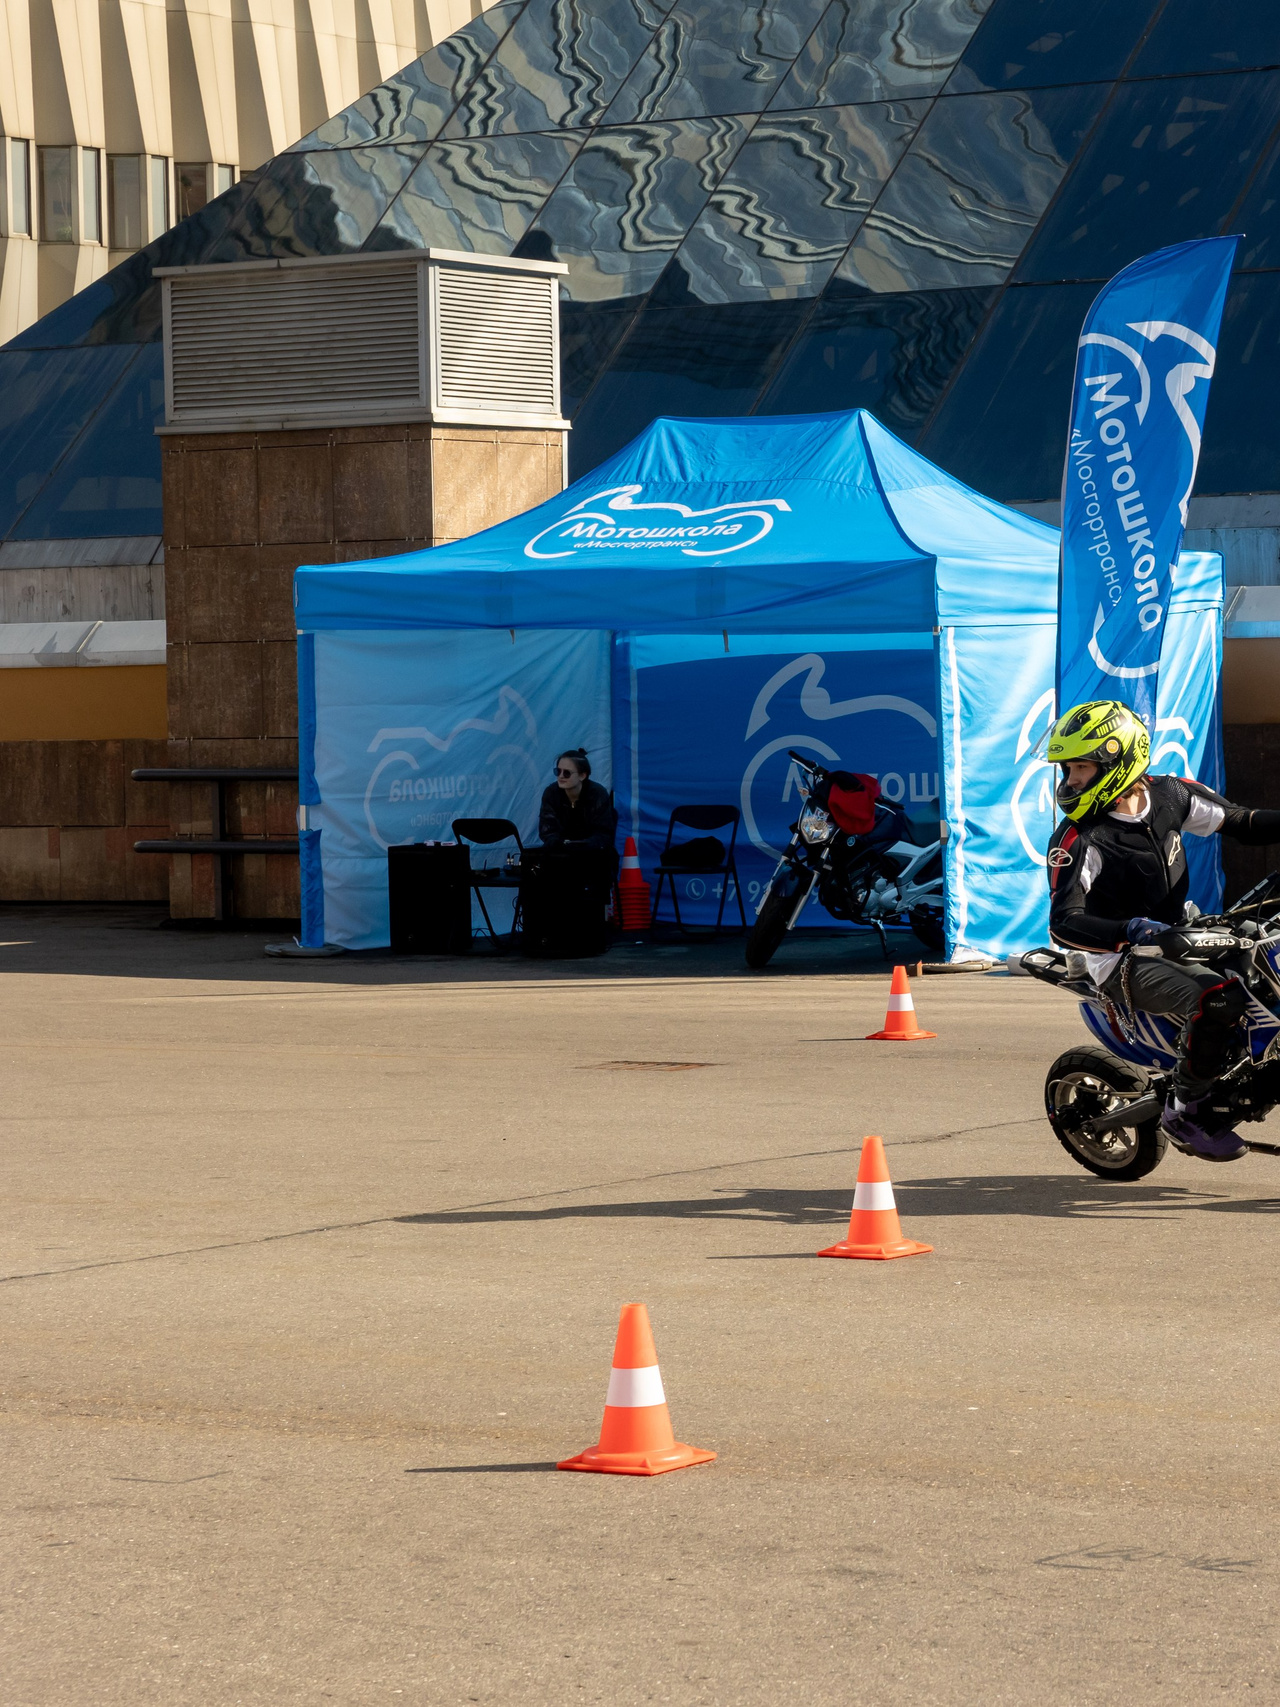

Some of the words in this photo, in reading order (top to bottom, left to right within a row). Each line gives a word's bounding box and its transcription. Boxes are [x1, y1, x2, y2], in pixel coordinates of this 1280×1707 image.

[1084, 372, 1163, 632] Мотошкола
[559, 522, 743, 538] Мотошкола
[573, 540, 698, 550] «Мосгортранс»
[1195, 938, 1236, 947] ACERBIS
